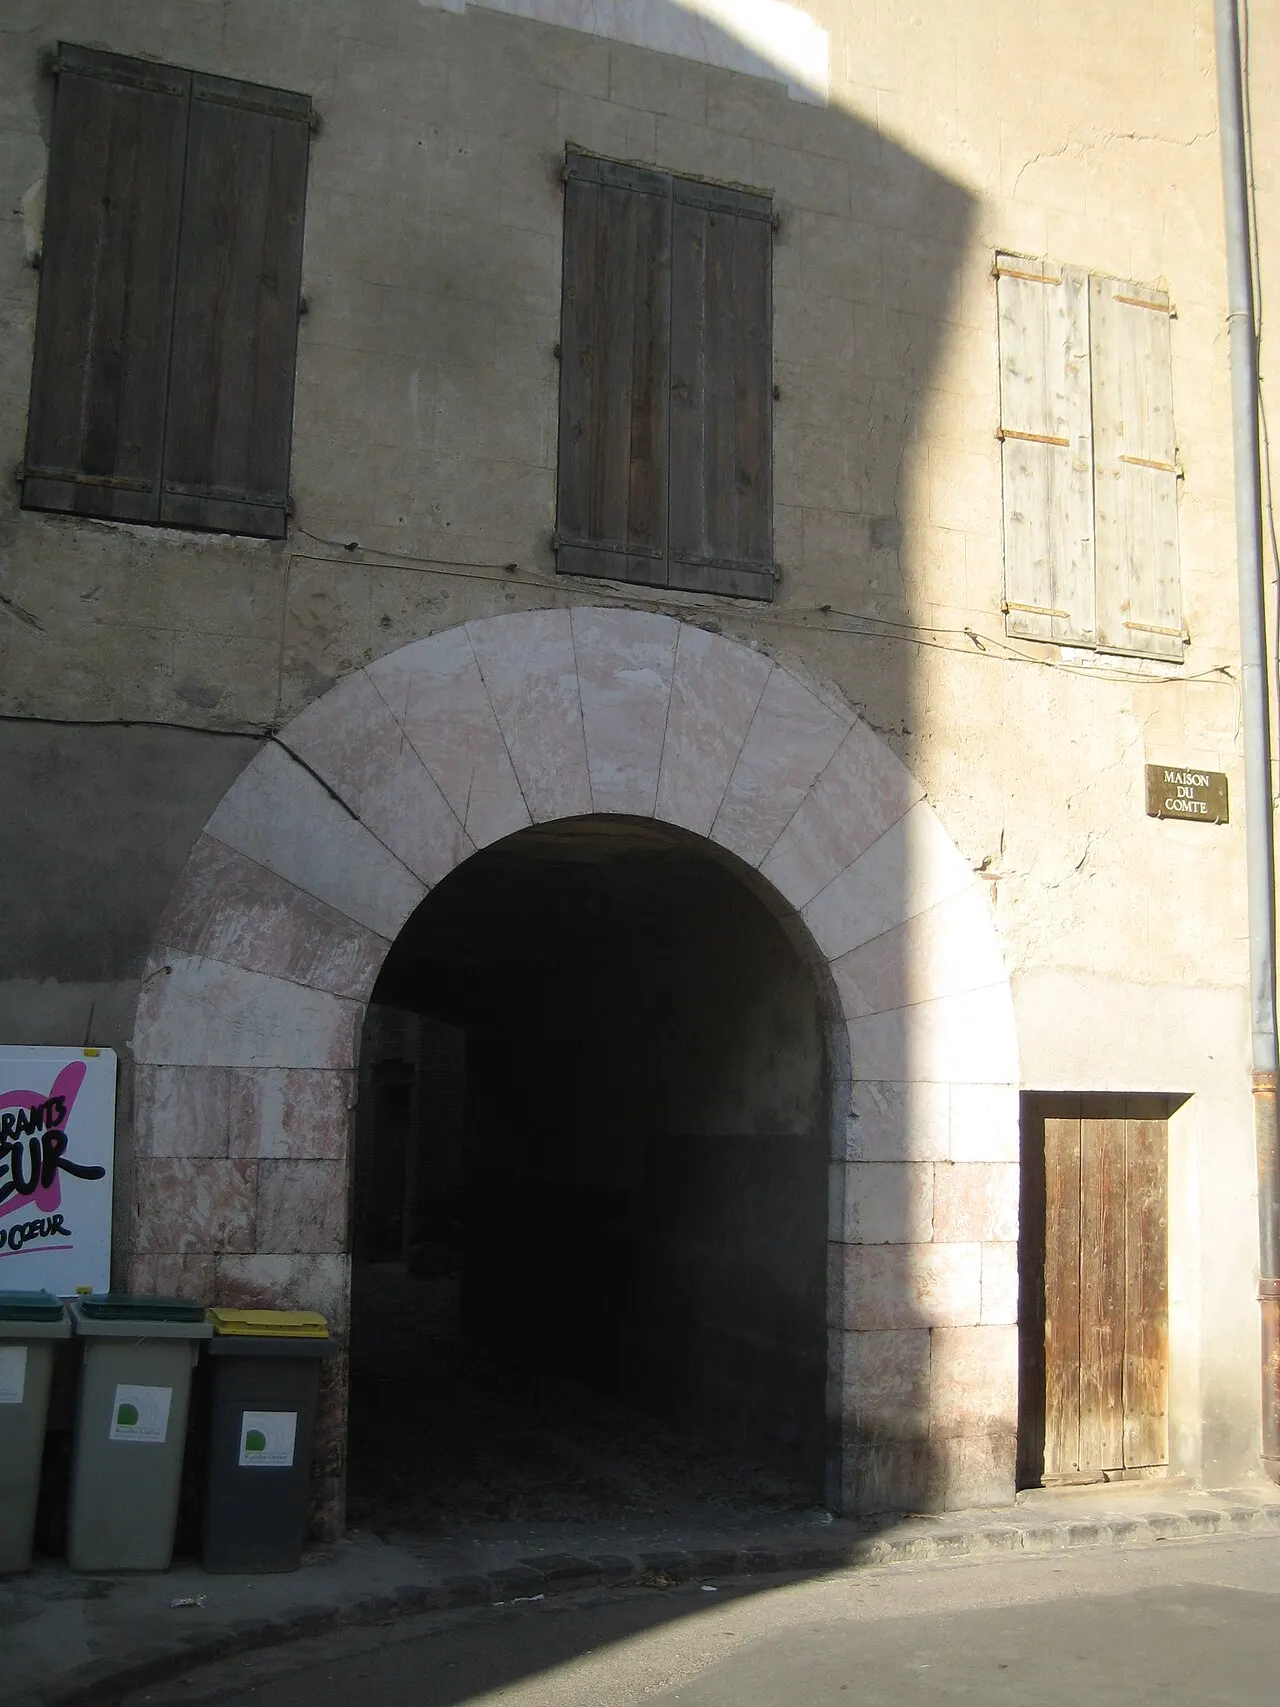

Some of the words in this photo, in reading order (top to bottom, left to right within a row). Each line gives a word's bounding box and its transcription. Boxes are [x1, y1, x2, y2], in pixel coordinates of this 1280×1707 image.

[1164, 771, 1209, 787] MAISON
[1177, 786, 1194, 799] DU
[1165, 798, 1208, 814] COMTE
